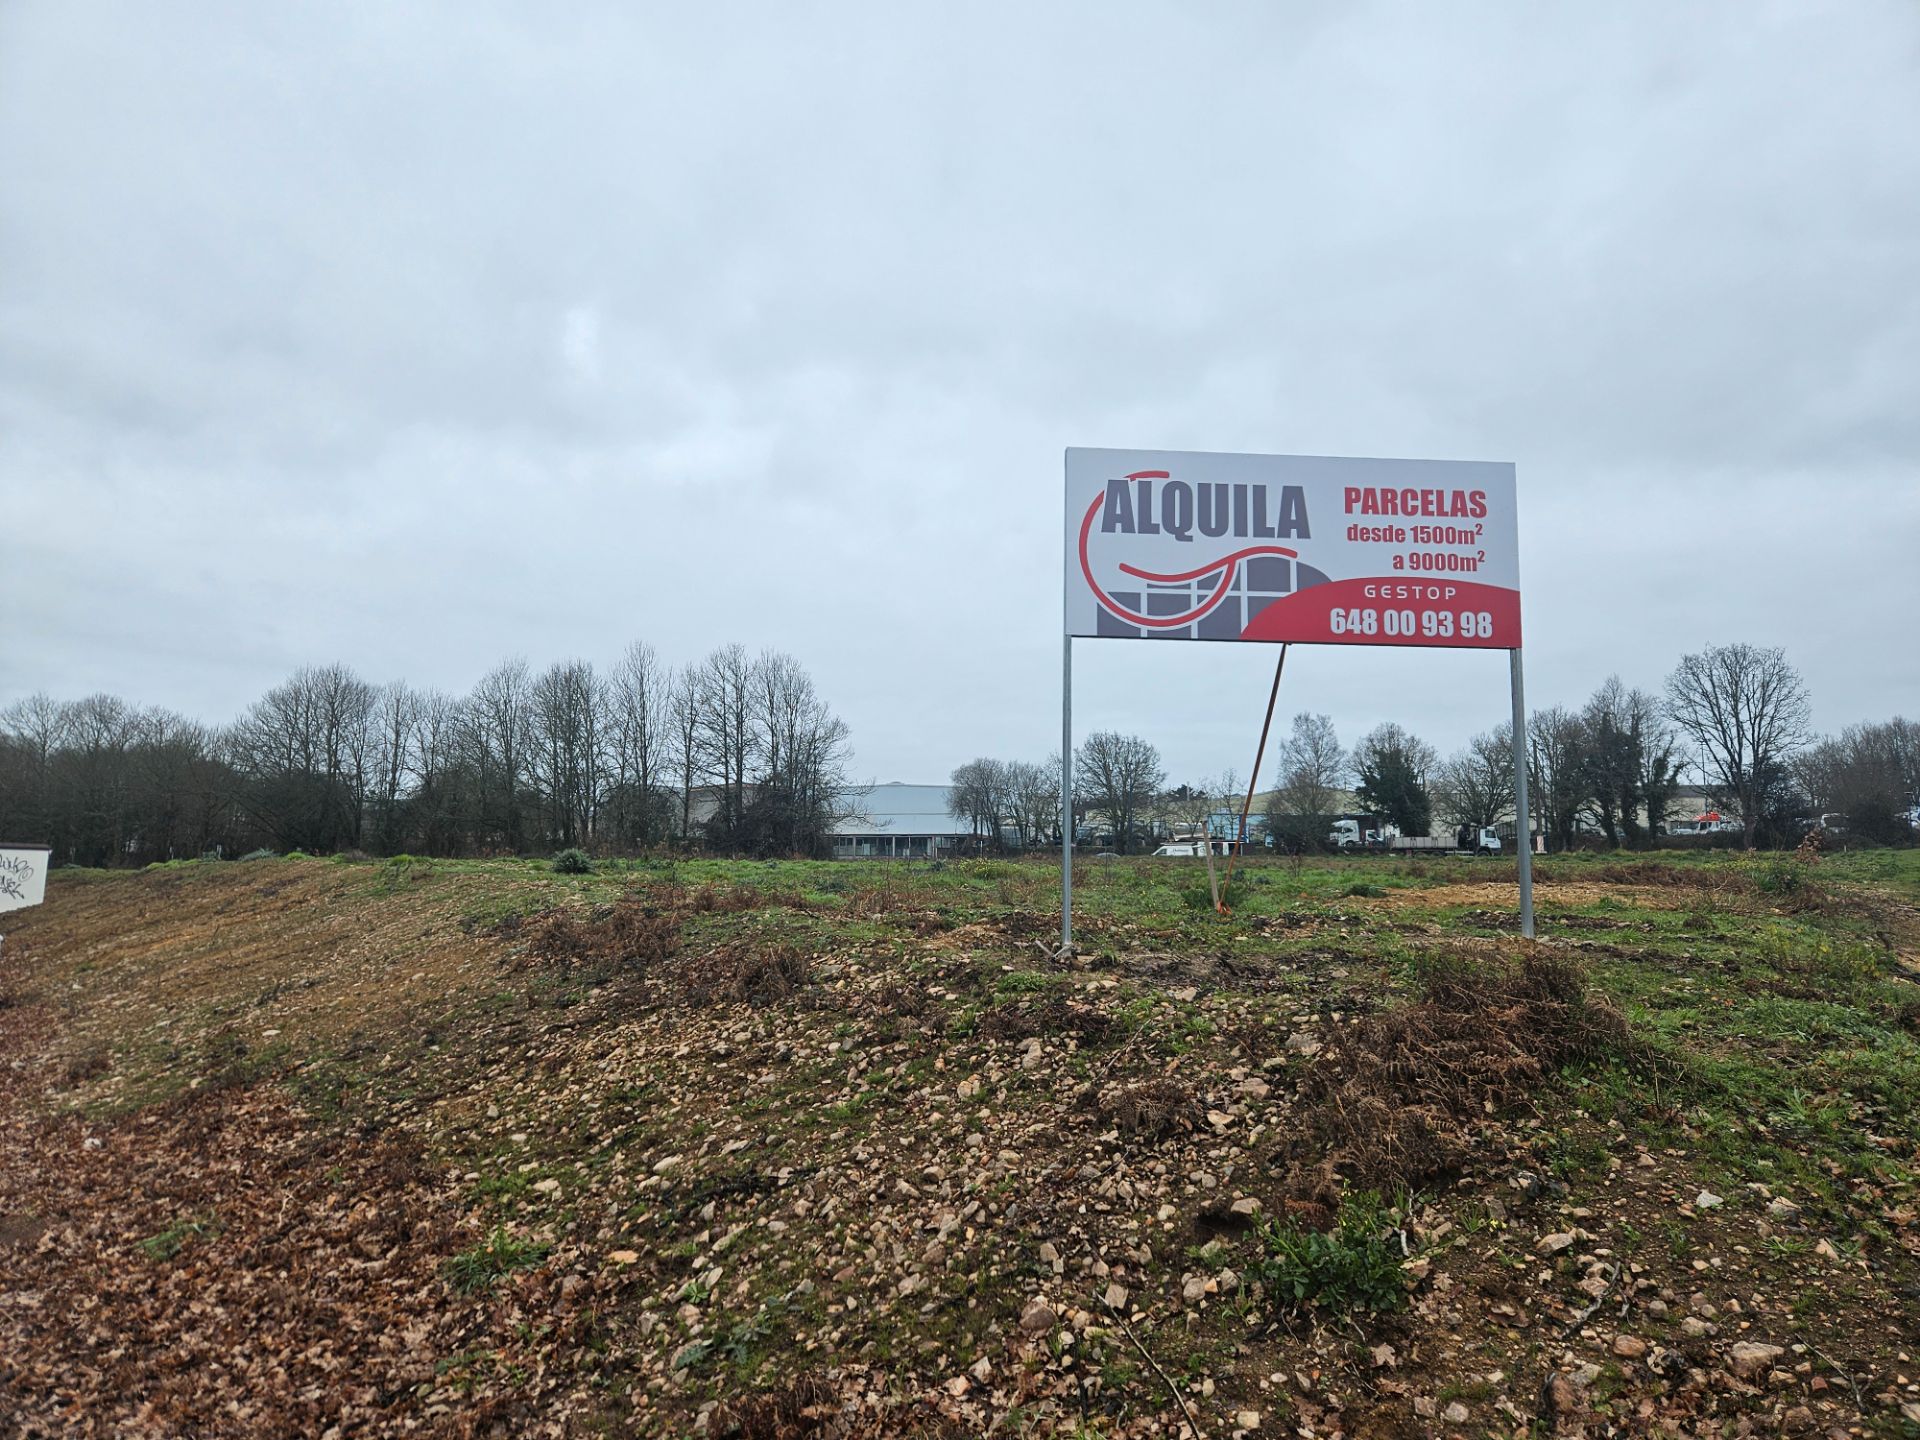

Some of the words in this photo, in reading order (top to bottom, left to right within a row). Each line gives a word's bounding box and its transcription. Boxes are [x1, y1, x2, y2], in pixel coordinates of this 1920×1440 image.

[1101, 479, 1311, 542] ALQUILA
[1344, 487, 1488, 518] PARCELAS
[1346, 524, 1406, 543] desde
[1392, 555, 1404, 570] a
[1364, 585, 1456, 600] GESTOP
[1330, 608, 1378, 636] 648
[1383, 609, 1416, 636] 00
[1421, 610, 1455, 637] 93
[1460, 611, 1493, 638] 98
